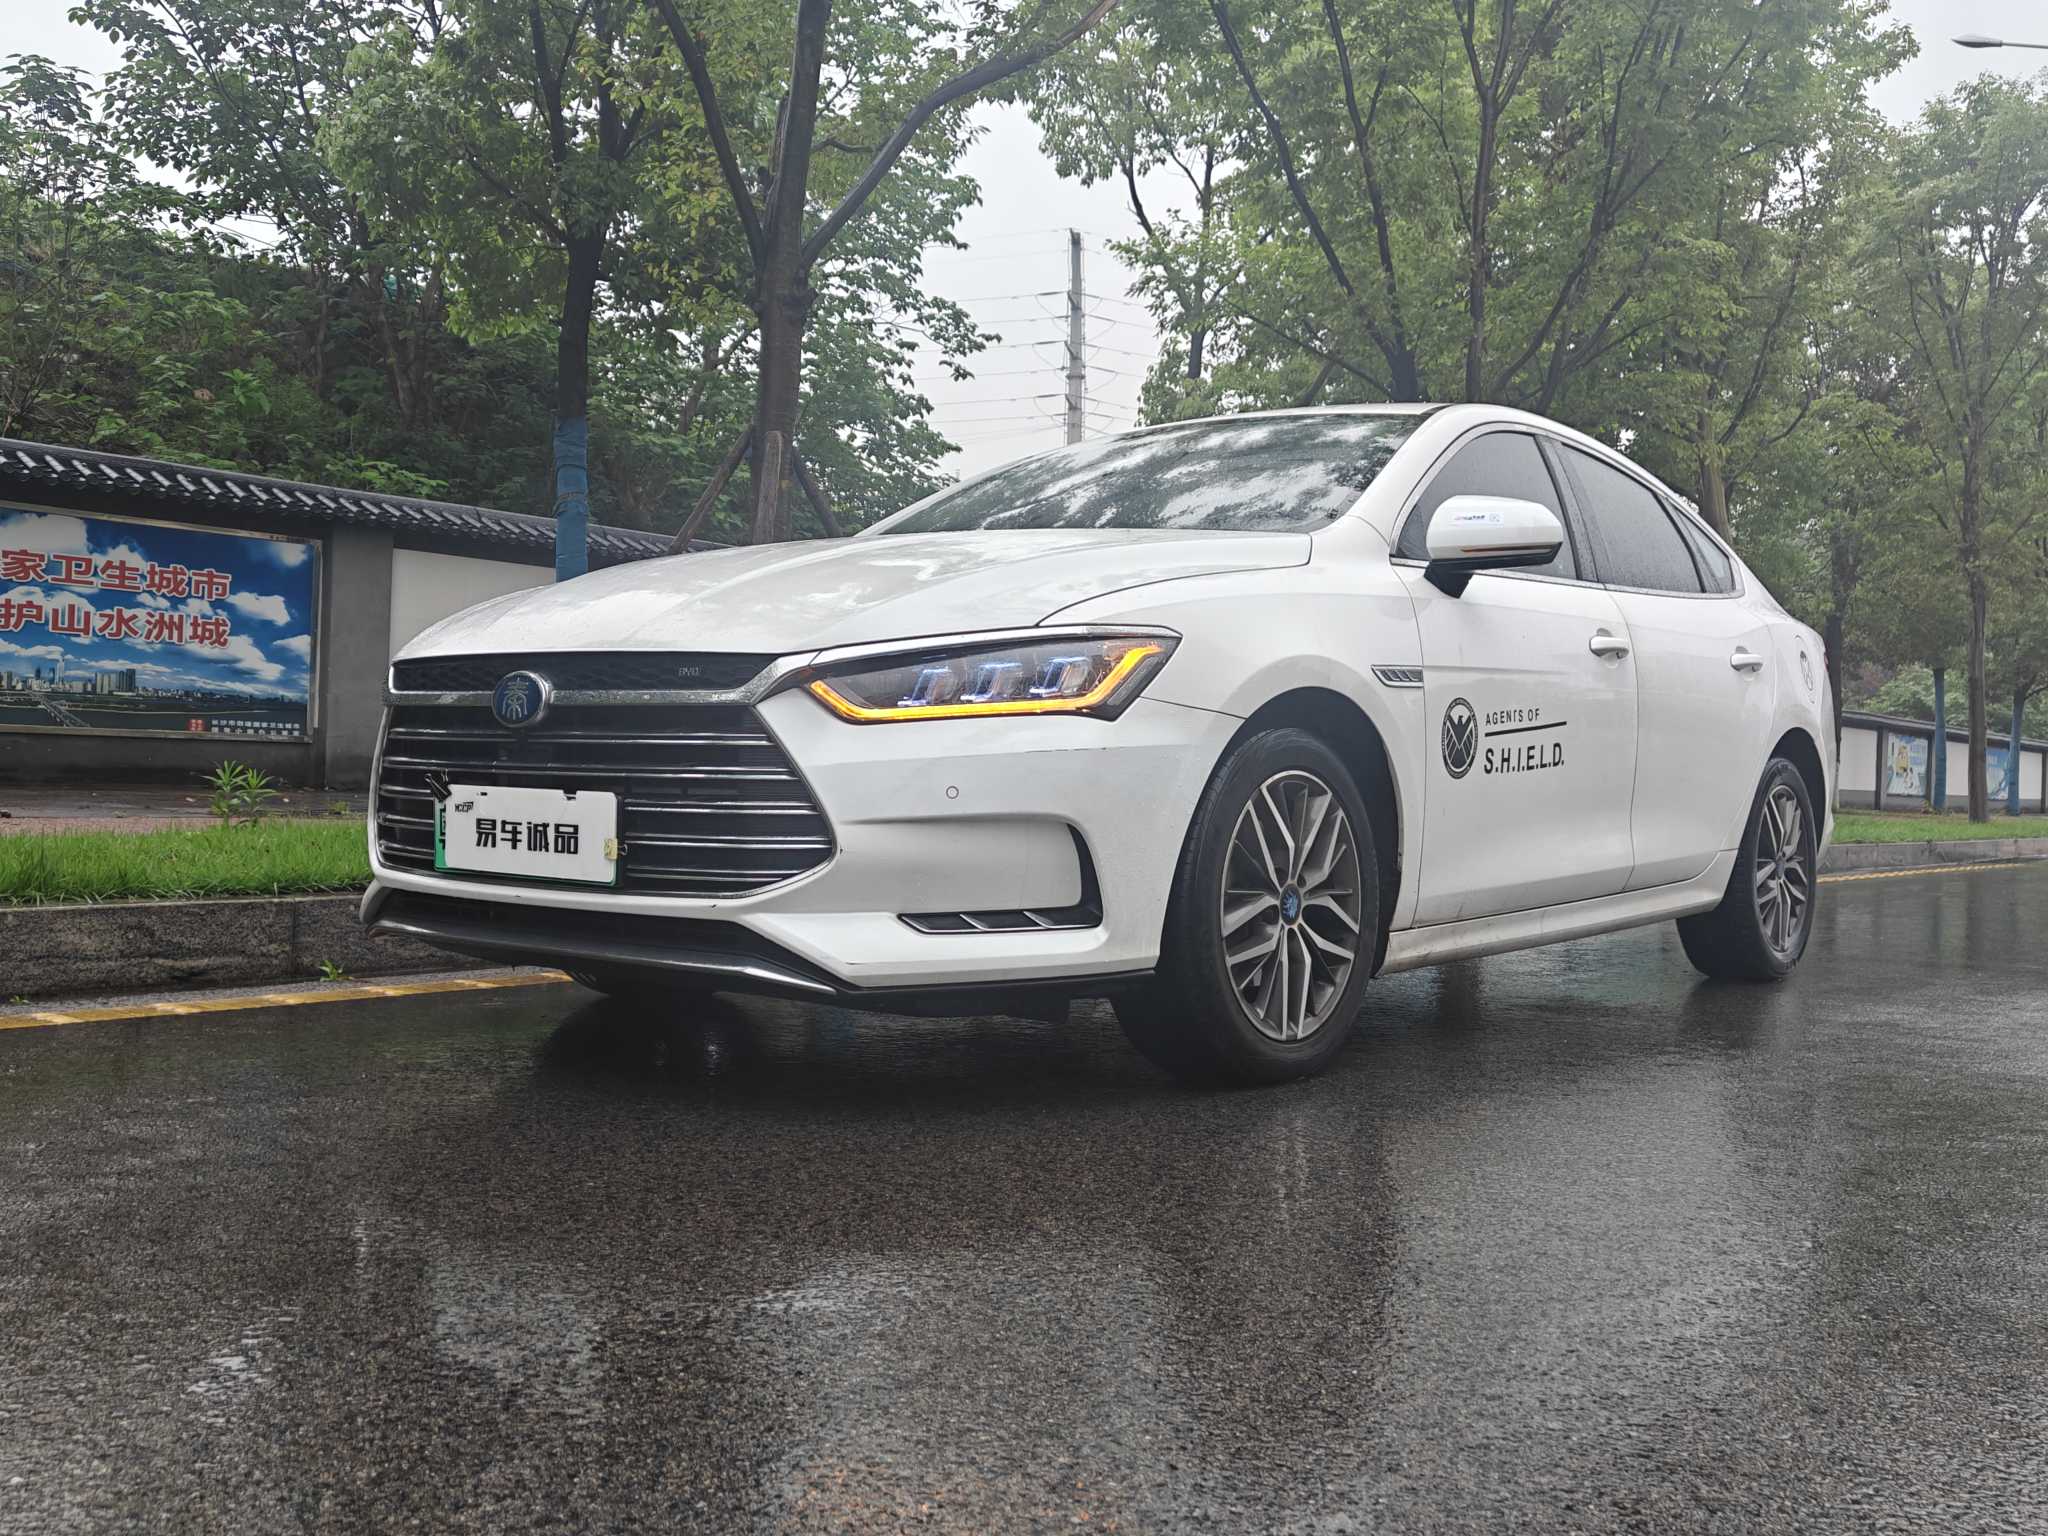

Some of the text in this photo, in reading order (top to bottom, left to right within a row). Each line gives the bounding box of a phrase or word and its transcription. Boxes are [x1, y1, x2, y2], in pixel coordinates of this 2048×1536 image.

[1, 548, 231, 600] 家卫生城市
[0, 598, 230, 648] 护山水洲城
[1485, 707, 1541, 726] AGENTS OF
[1483, 742, 1565, 775] S.H.I.E.L.D.
[475, 818, 580, 855] 易车诚品
